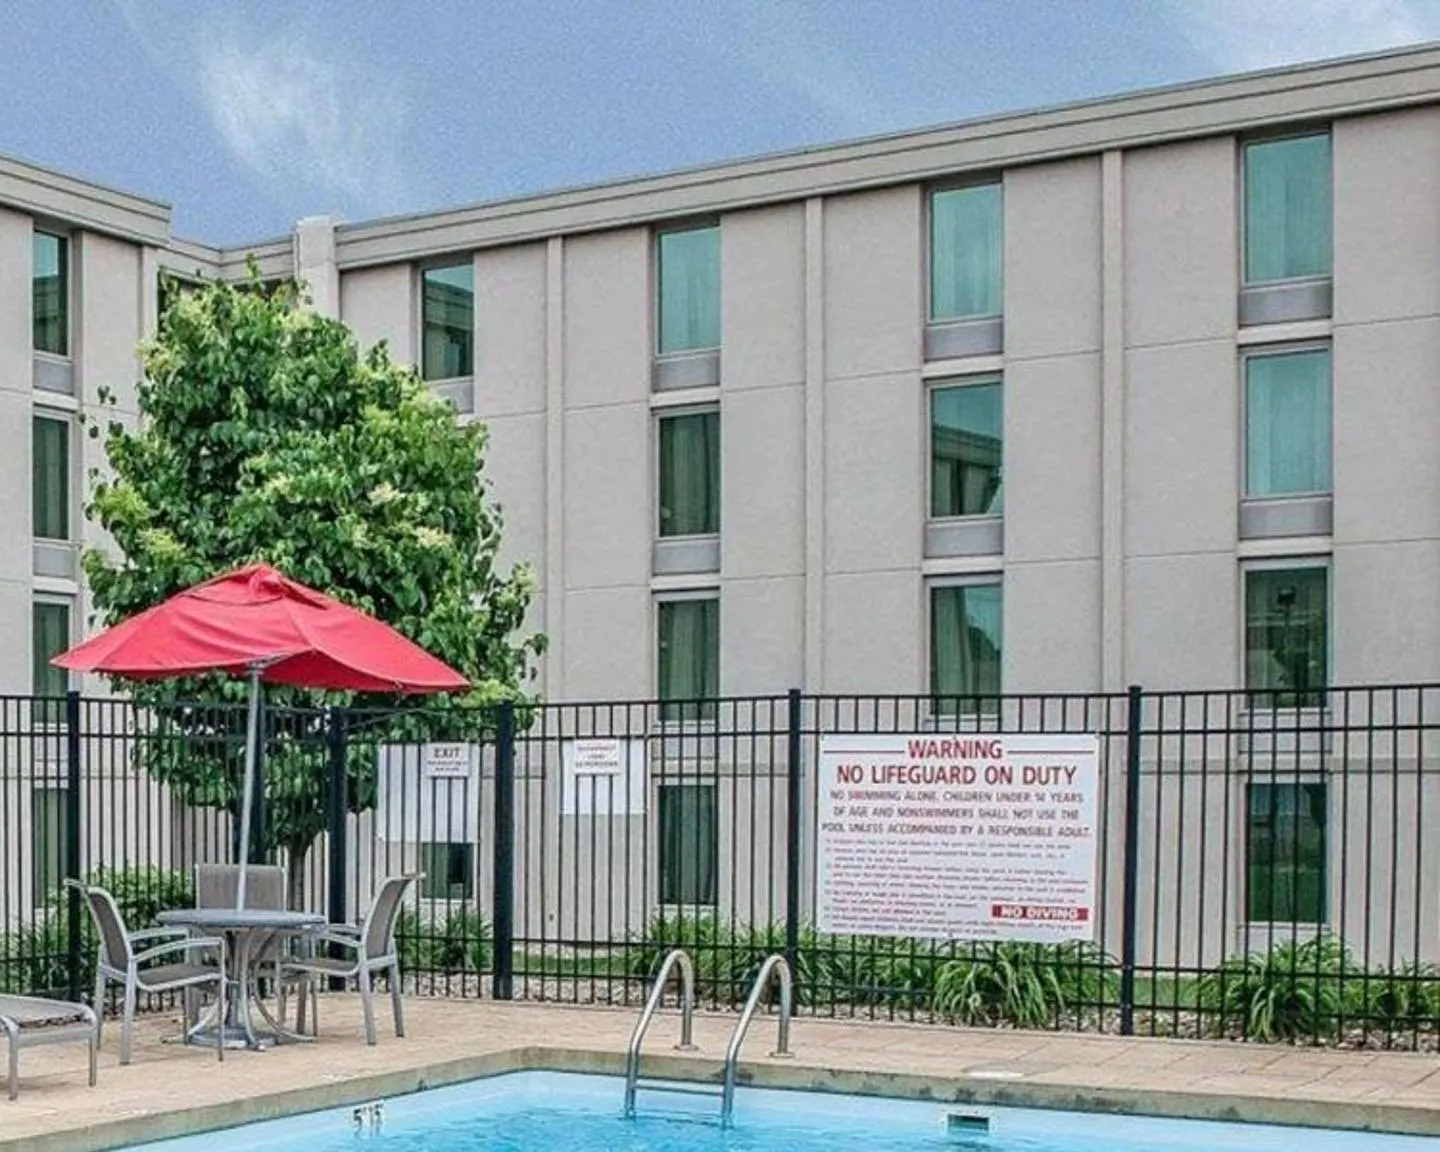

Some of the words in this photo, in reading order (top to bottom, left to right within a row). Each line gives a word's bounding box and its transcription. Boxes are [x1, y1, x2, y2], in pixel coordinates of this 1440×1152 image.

[908, 740, 1002, 759] WARNING
[837, 765, 863, 784] NO
[871, 765, 976, 785] LIFEGUARD
[984, 765, 1013, 785] ON
[1023, 765, 1076, 785] DUTY
[848, 790, 901, 801] SWIMMING
[943, 791, 992, 801] CHILDREN
[996, 792, 1030, 802] UNDER
[1051, 792, 1084, 803] YEARS
[848, 806, 868, 817] AGE
[872, 807, 894, 817] AND
[1012, 809, 1033, 819] NOT
[977, 825, 984, 834] A
[1001, 905, 1022, 918] NO
[1027, 905, 1078, 920] DIVING
